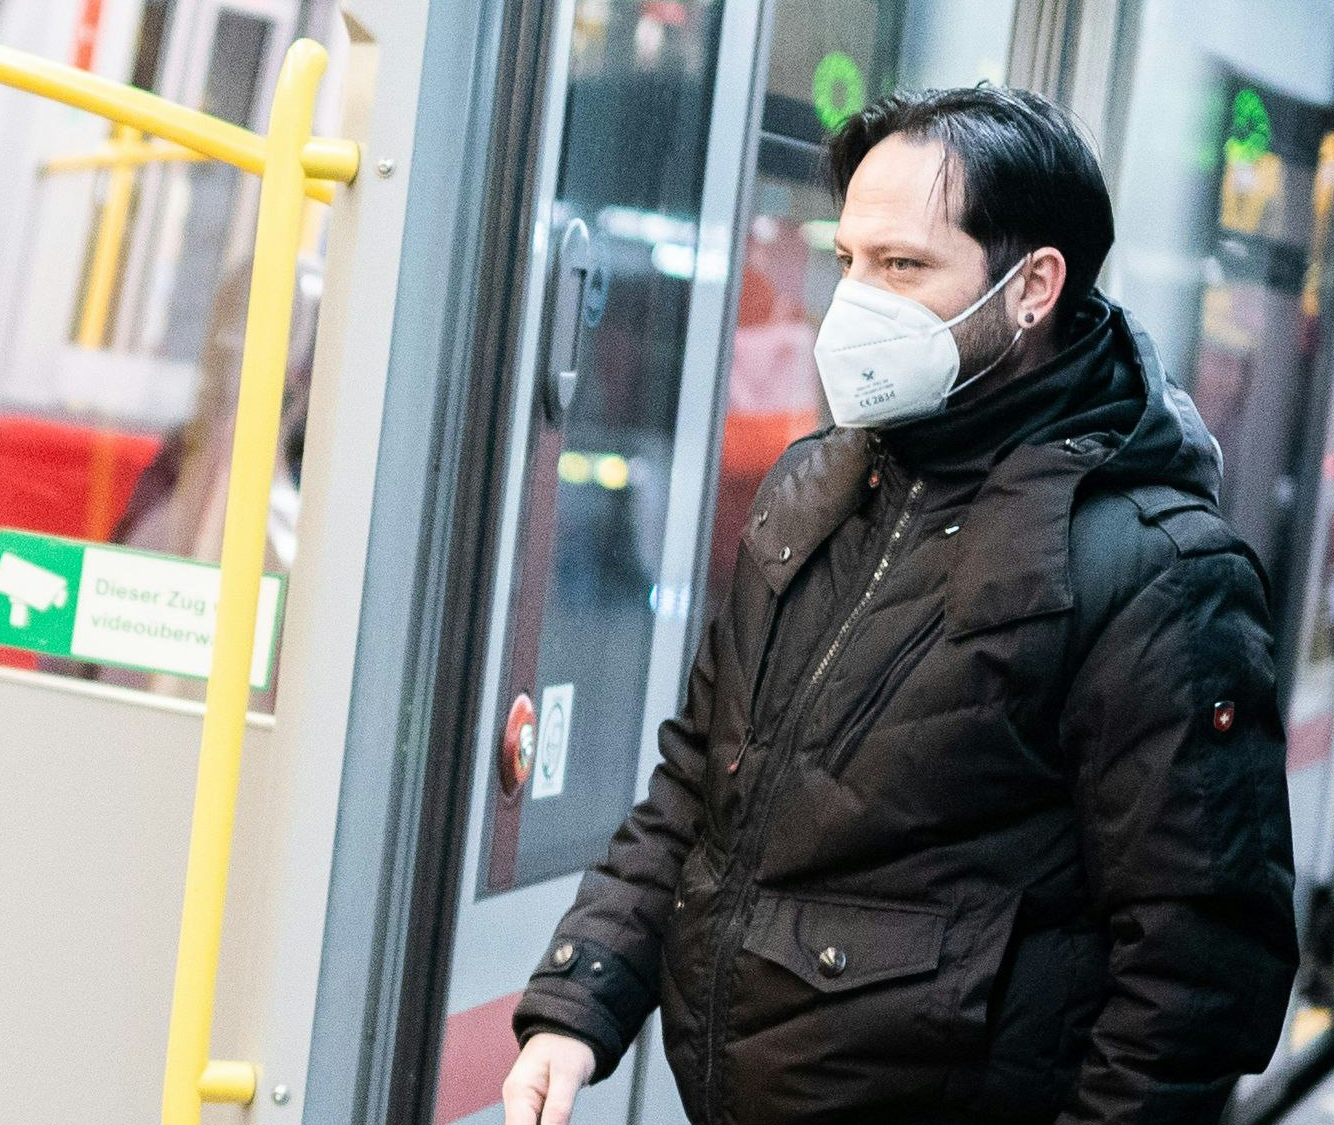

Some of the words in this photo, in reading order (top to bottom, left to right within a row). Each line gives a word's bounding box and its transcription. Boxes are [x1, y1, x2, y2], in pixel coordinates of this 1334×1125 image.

[96, 578, 159, 604] Dieser
[166, 590, 207, 616] Zug
[92, 613, 213, 645] videoüberw
